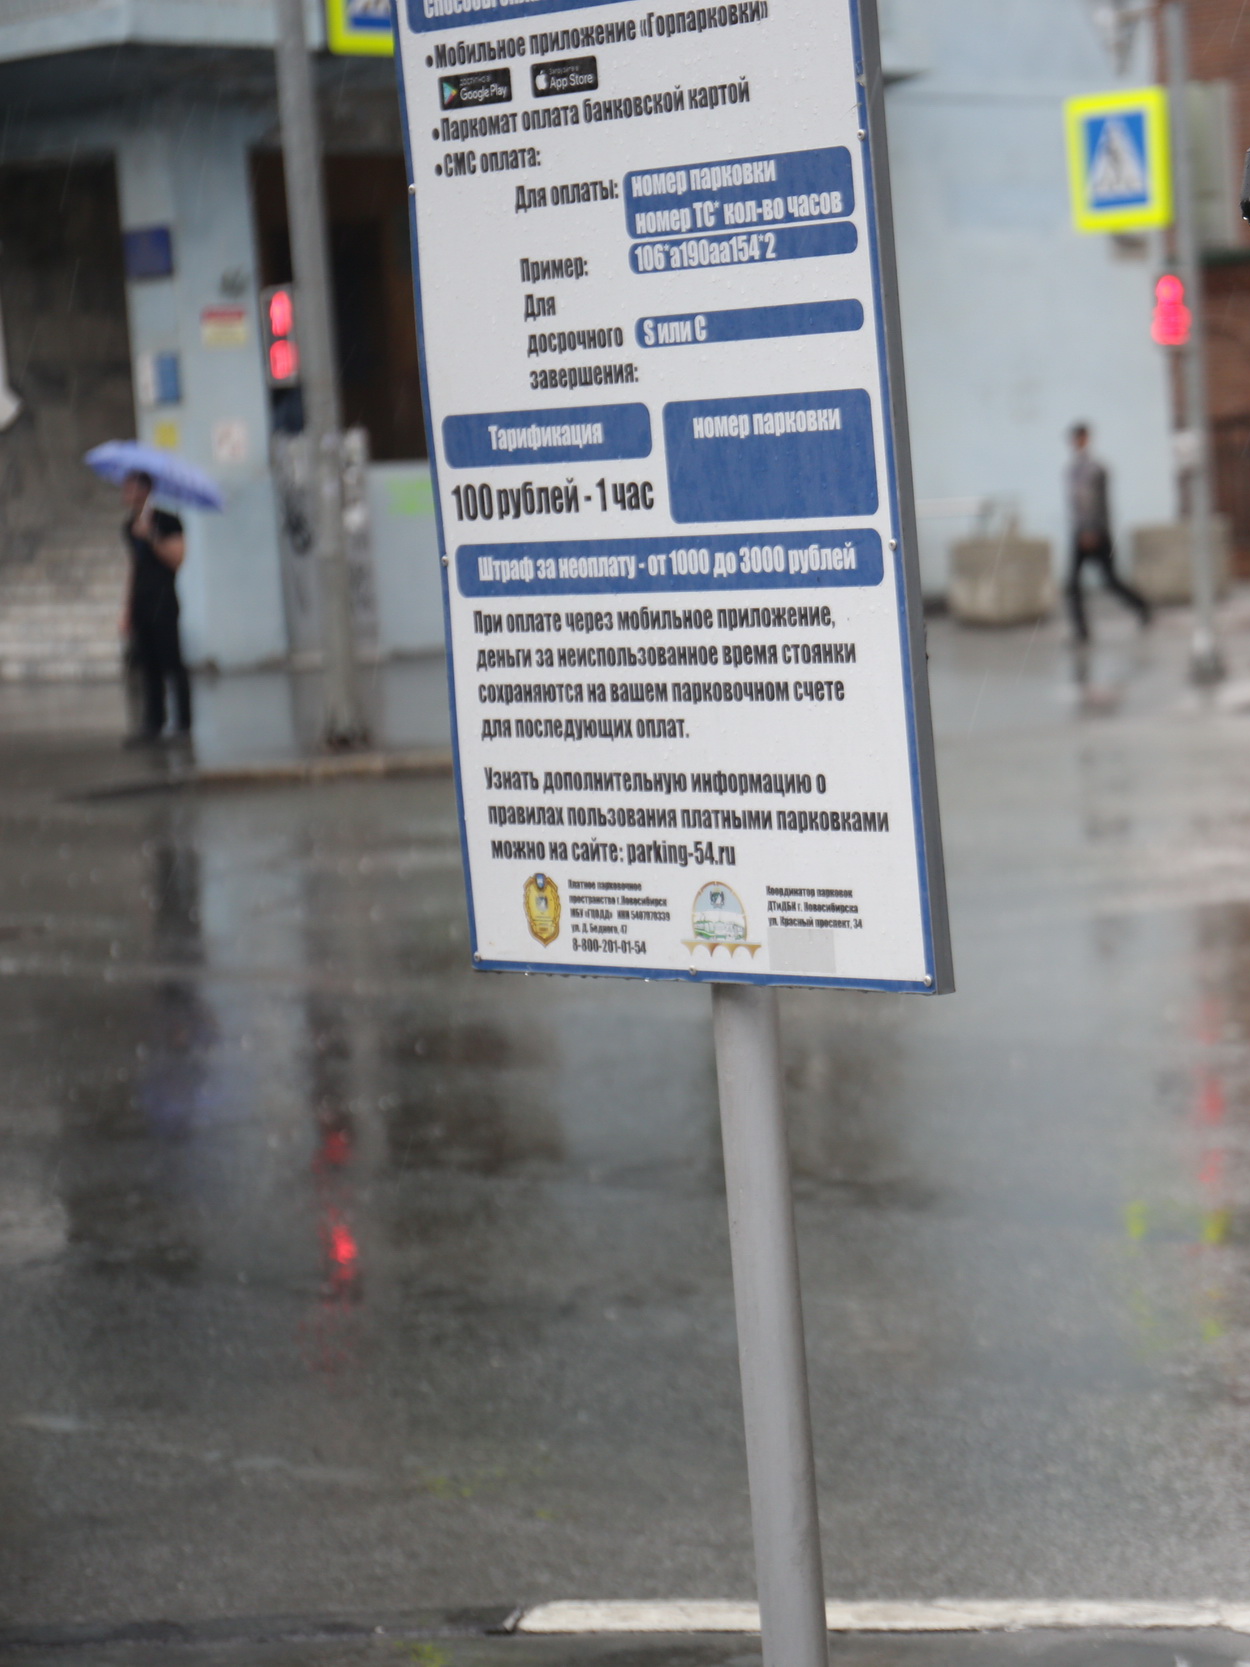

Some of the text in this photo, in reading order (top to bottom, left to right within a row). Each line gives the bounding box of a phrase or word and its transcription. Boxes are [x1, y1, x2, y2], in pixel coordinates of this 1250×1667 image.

[434, 1, 768, 68] Мобильное приложение «Горпарковки»
[460, 83, 507, 101] Google Play
[550, 73, 594, 91] App Store
[440, 75, 750, 142] Паркомат оплата банковской картой
[443, 147, 541, 177] СМС оплата:
[631, 160, 777, 197] номер парковки
[515, 179, 619, 213] Для оплаты:
[635, 207, 691, 234] номер
[723, 197, 785, 225] кол-во
[787, 191, 842, 216] часов
[520, 256, 588, 283] Пример:
[524, 294, 556, 322] Для
[527, 327, 623, 358] досрочного
[643, 319, 655, 346] S
[657, 318, 692, 344] или
[529, 362, 639, 390] завершения:
[488, 422, 603, 451] Тарификация
[693, 408, 841, 439] номер парковки
[452, 483, 493, 521] 100
[496, 477, 579, 520] рублей
[595, 478, 607, 512] 1
[611, 481, 654, 510] час
[478, 556, 534, 583] Штраф
[536, 558, 556, 579] за
[558, 555, 636, 580] неоплату
[648, 554, 666, 576] от
[669, 549, 709, 575] 1000
[713, 551, 736, 577] до
[738, 545, 784, 574] 3000
[788, 541, 856, 574] рублей
[473, 605, 836, 636] При оплате через мобильное приложение,
[477, 642, 856, 672] деньги за неиспользованное время стоянки
[478, 680, 845, 705] сохраняются на вашем парковочном счете
[481, 718, 689, 741] для последующих оплат.
[484, 766, 826, 797] Узнать дополнительную информацию о
[488, 805, 889, 833] правилах пользования платными парковками
[491, 837, 736, 867] можно на сайте: parking-54.ru
